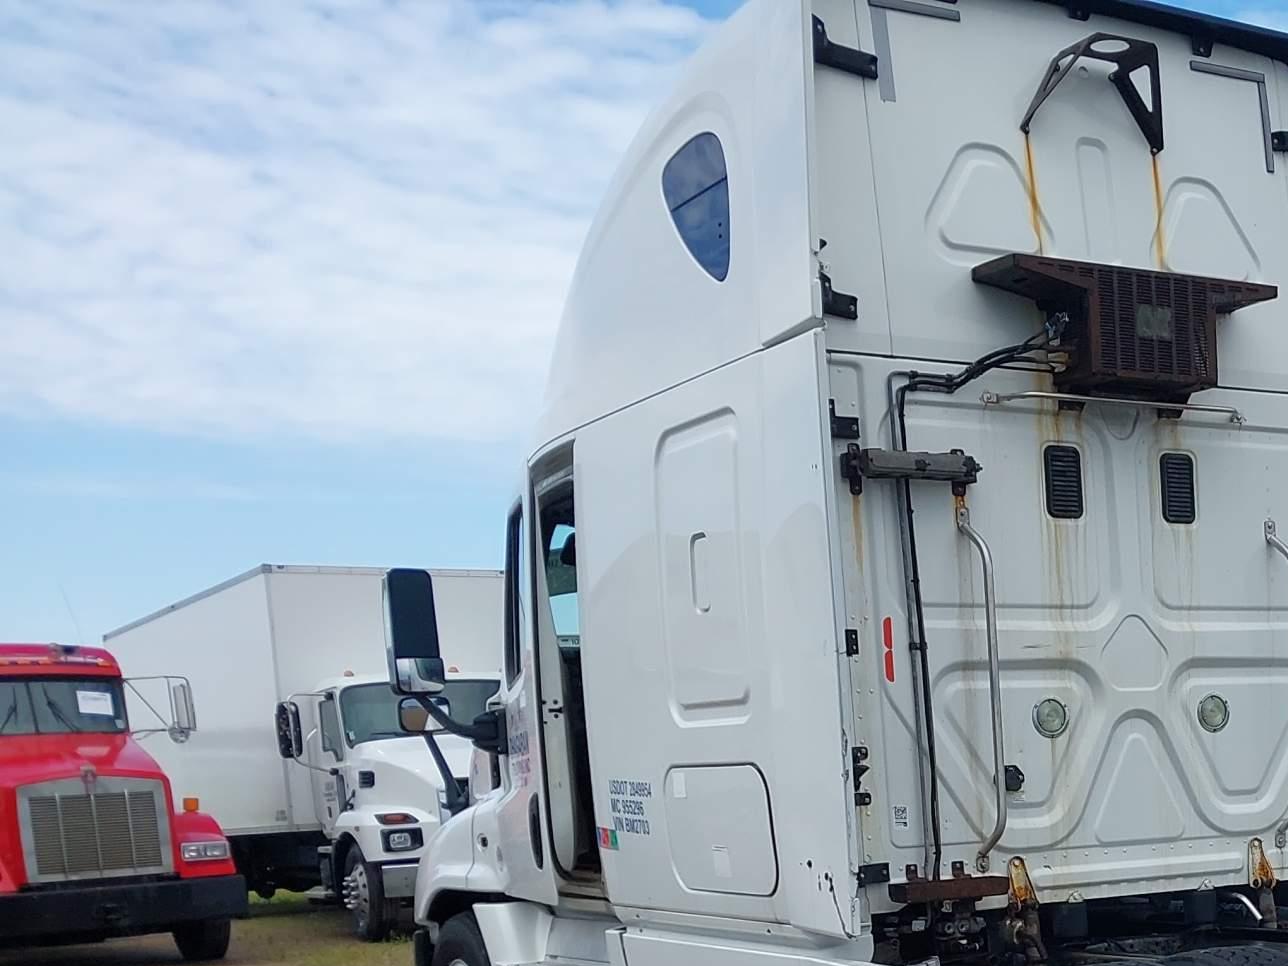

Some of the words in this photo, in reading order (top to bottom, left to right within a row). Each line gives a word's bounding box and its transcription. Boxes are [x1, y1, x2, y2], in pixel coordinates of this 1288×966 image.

[609, 780, 627, 796] USDOT
[611, 798, 621, 814] MC
[613, 816, 624, 832] VIN
